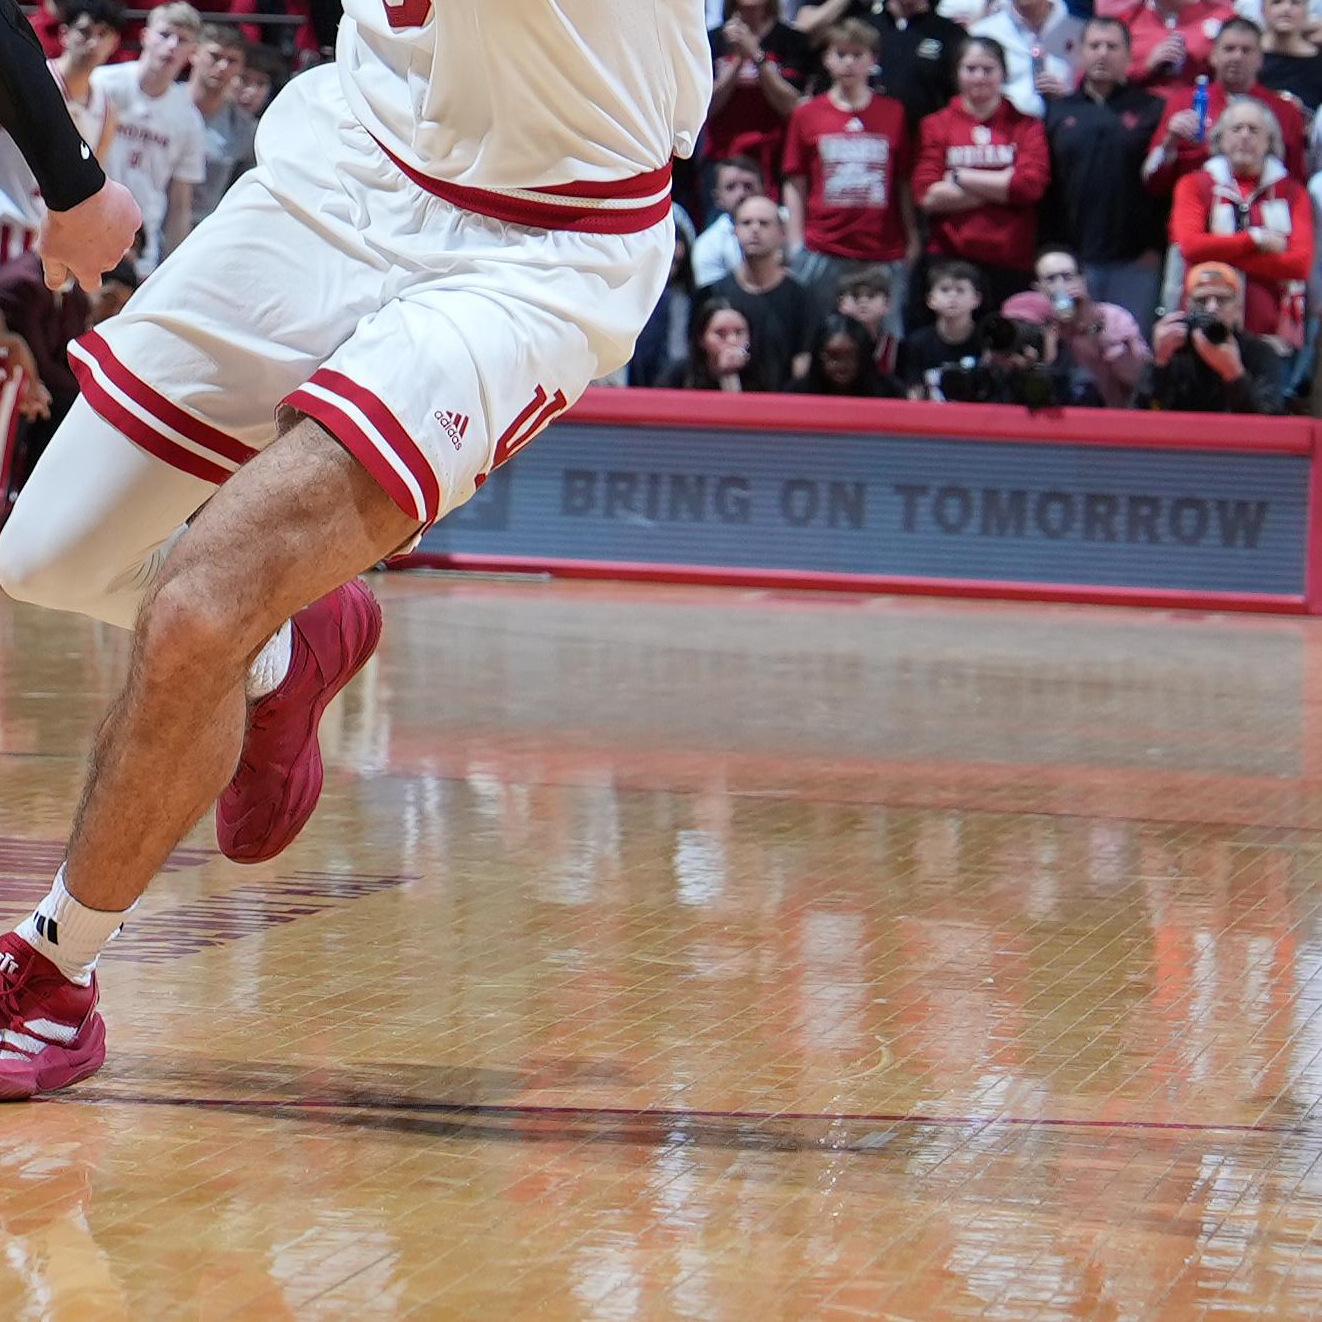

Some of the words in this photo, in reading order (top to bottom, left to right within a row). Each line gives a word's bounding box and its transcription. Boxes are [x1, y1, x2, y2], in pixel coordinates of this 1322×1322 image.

[434, 410, 463, 451] adidas
[560, 469, 752, 525] BRING
[779, 479, 865, 530] ON
[893, 484, 1270, 551] TOMORROW
